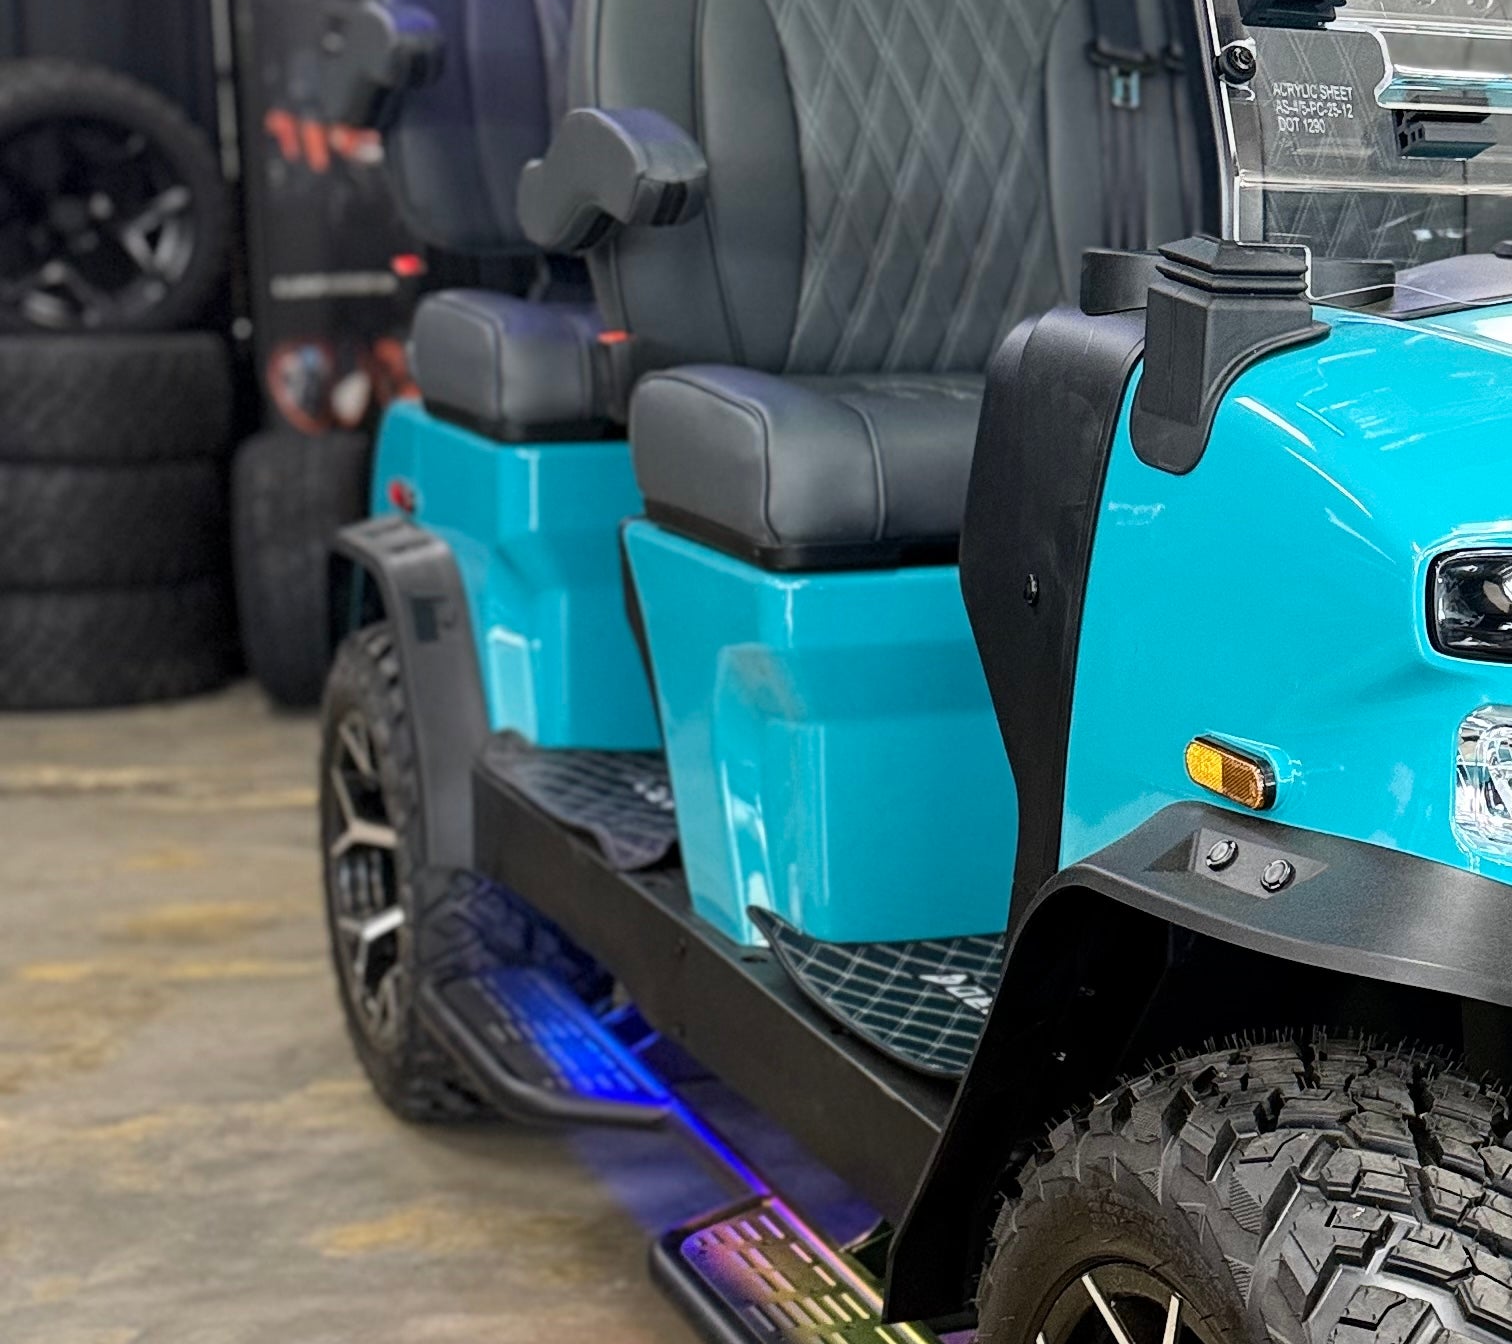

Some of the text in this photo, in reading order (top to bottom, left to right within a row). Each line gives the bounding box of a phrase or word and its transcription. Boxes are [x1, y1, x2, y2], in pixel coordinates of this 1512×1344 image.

[1272, 82, 1353, 101] ACRYLIC SHEET
[1277, 115, 1300, 133] DOT
